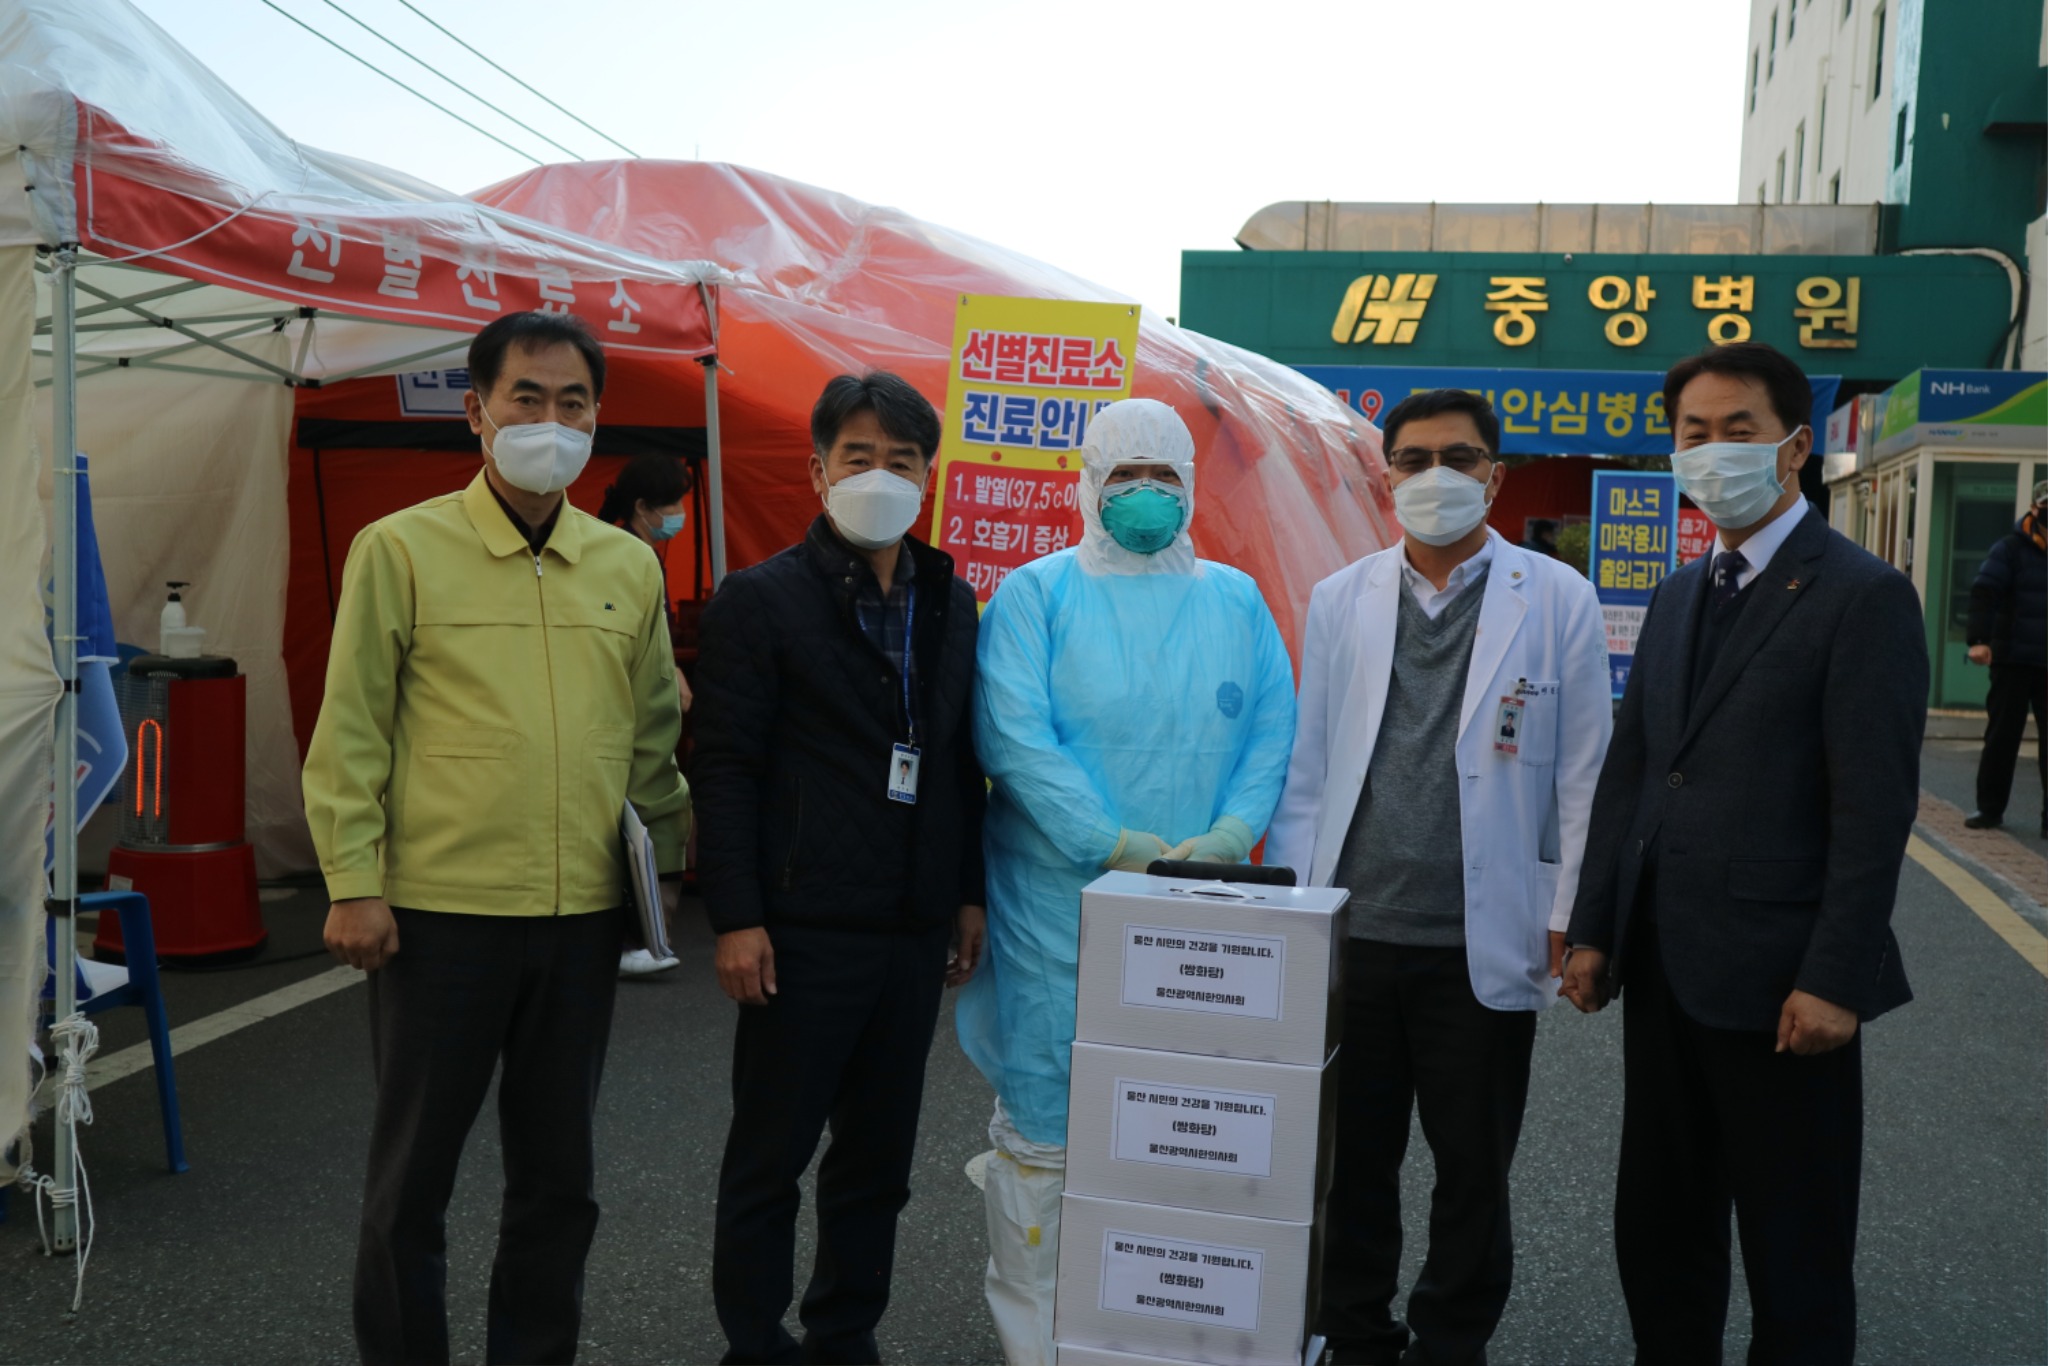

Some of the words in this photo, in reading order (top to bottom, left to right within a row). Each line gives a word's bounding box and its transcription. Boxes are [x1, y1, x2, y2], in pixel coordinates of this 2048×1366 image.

[1484, 274, 1861, 349] 중앙병원
[960, 329, 1126, 390] 선별진료소
[1931, 381, 1966, 396] NH
[1966, 383, 1991, 395] Bank
[954, 473, 969, 501] 1.
[1610, 487, 1660, 518] 마스크
[948, 516, 967, 545] 2.
[972, 517, 1028, 553] 호흡기
[1033, 524, 1069, 555] 증상
[1601, 523, 1667, 554] 미착용시
[1678, 518, 1708, 536] 흡기
[1600, 558, 1665, 589] 출입금지
[1134, 935, 1153, 946] 울산
[1156, 937, 1186, 950] 시민의
[1188, 940, 1218, 953] 건강을
[1221, 943, 1274, 959] 기원합니다.
[1179, 963, 1224, 979] (쌍화탕)
[1156, 987, 1245, 1006] 울산광역시한의사회
[1127, 1091, 1146, 1103] 울산
[1149, 1093, 1178, 1106] 시민의
[1181, 1097, 1210, 1110] 건강을
[1214, 1100, 1266, 1116] 기원합니다.
[1172, 1120, 1217, 1136] (쌍화탕)
[1149, 1143, 1237, 1163] 울산광역시한의사회
[1114, 1241, 1134, 1253] 울산
[1136, 1244, 1166, 1258] 시민의
[1168, 1249, 1198, 1263] 건강을
[1201, 1253, 1254, 1270] 기원합니다.
[1159, 1272, 1204, 1289] (쌍화탕)
[1136, 1294, 1225, 1316] 울산광역시한의사회
